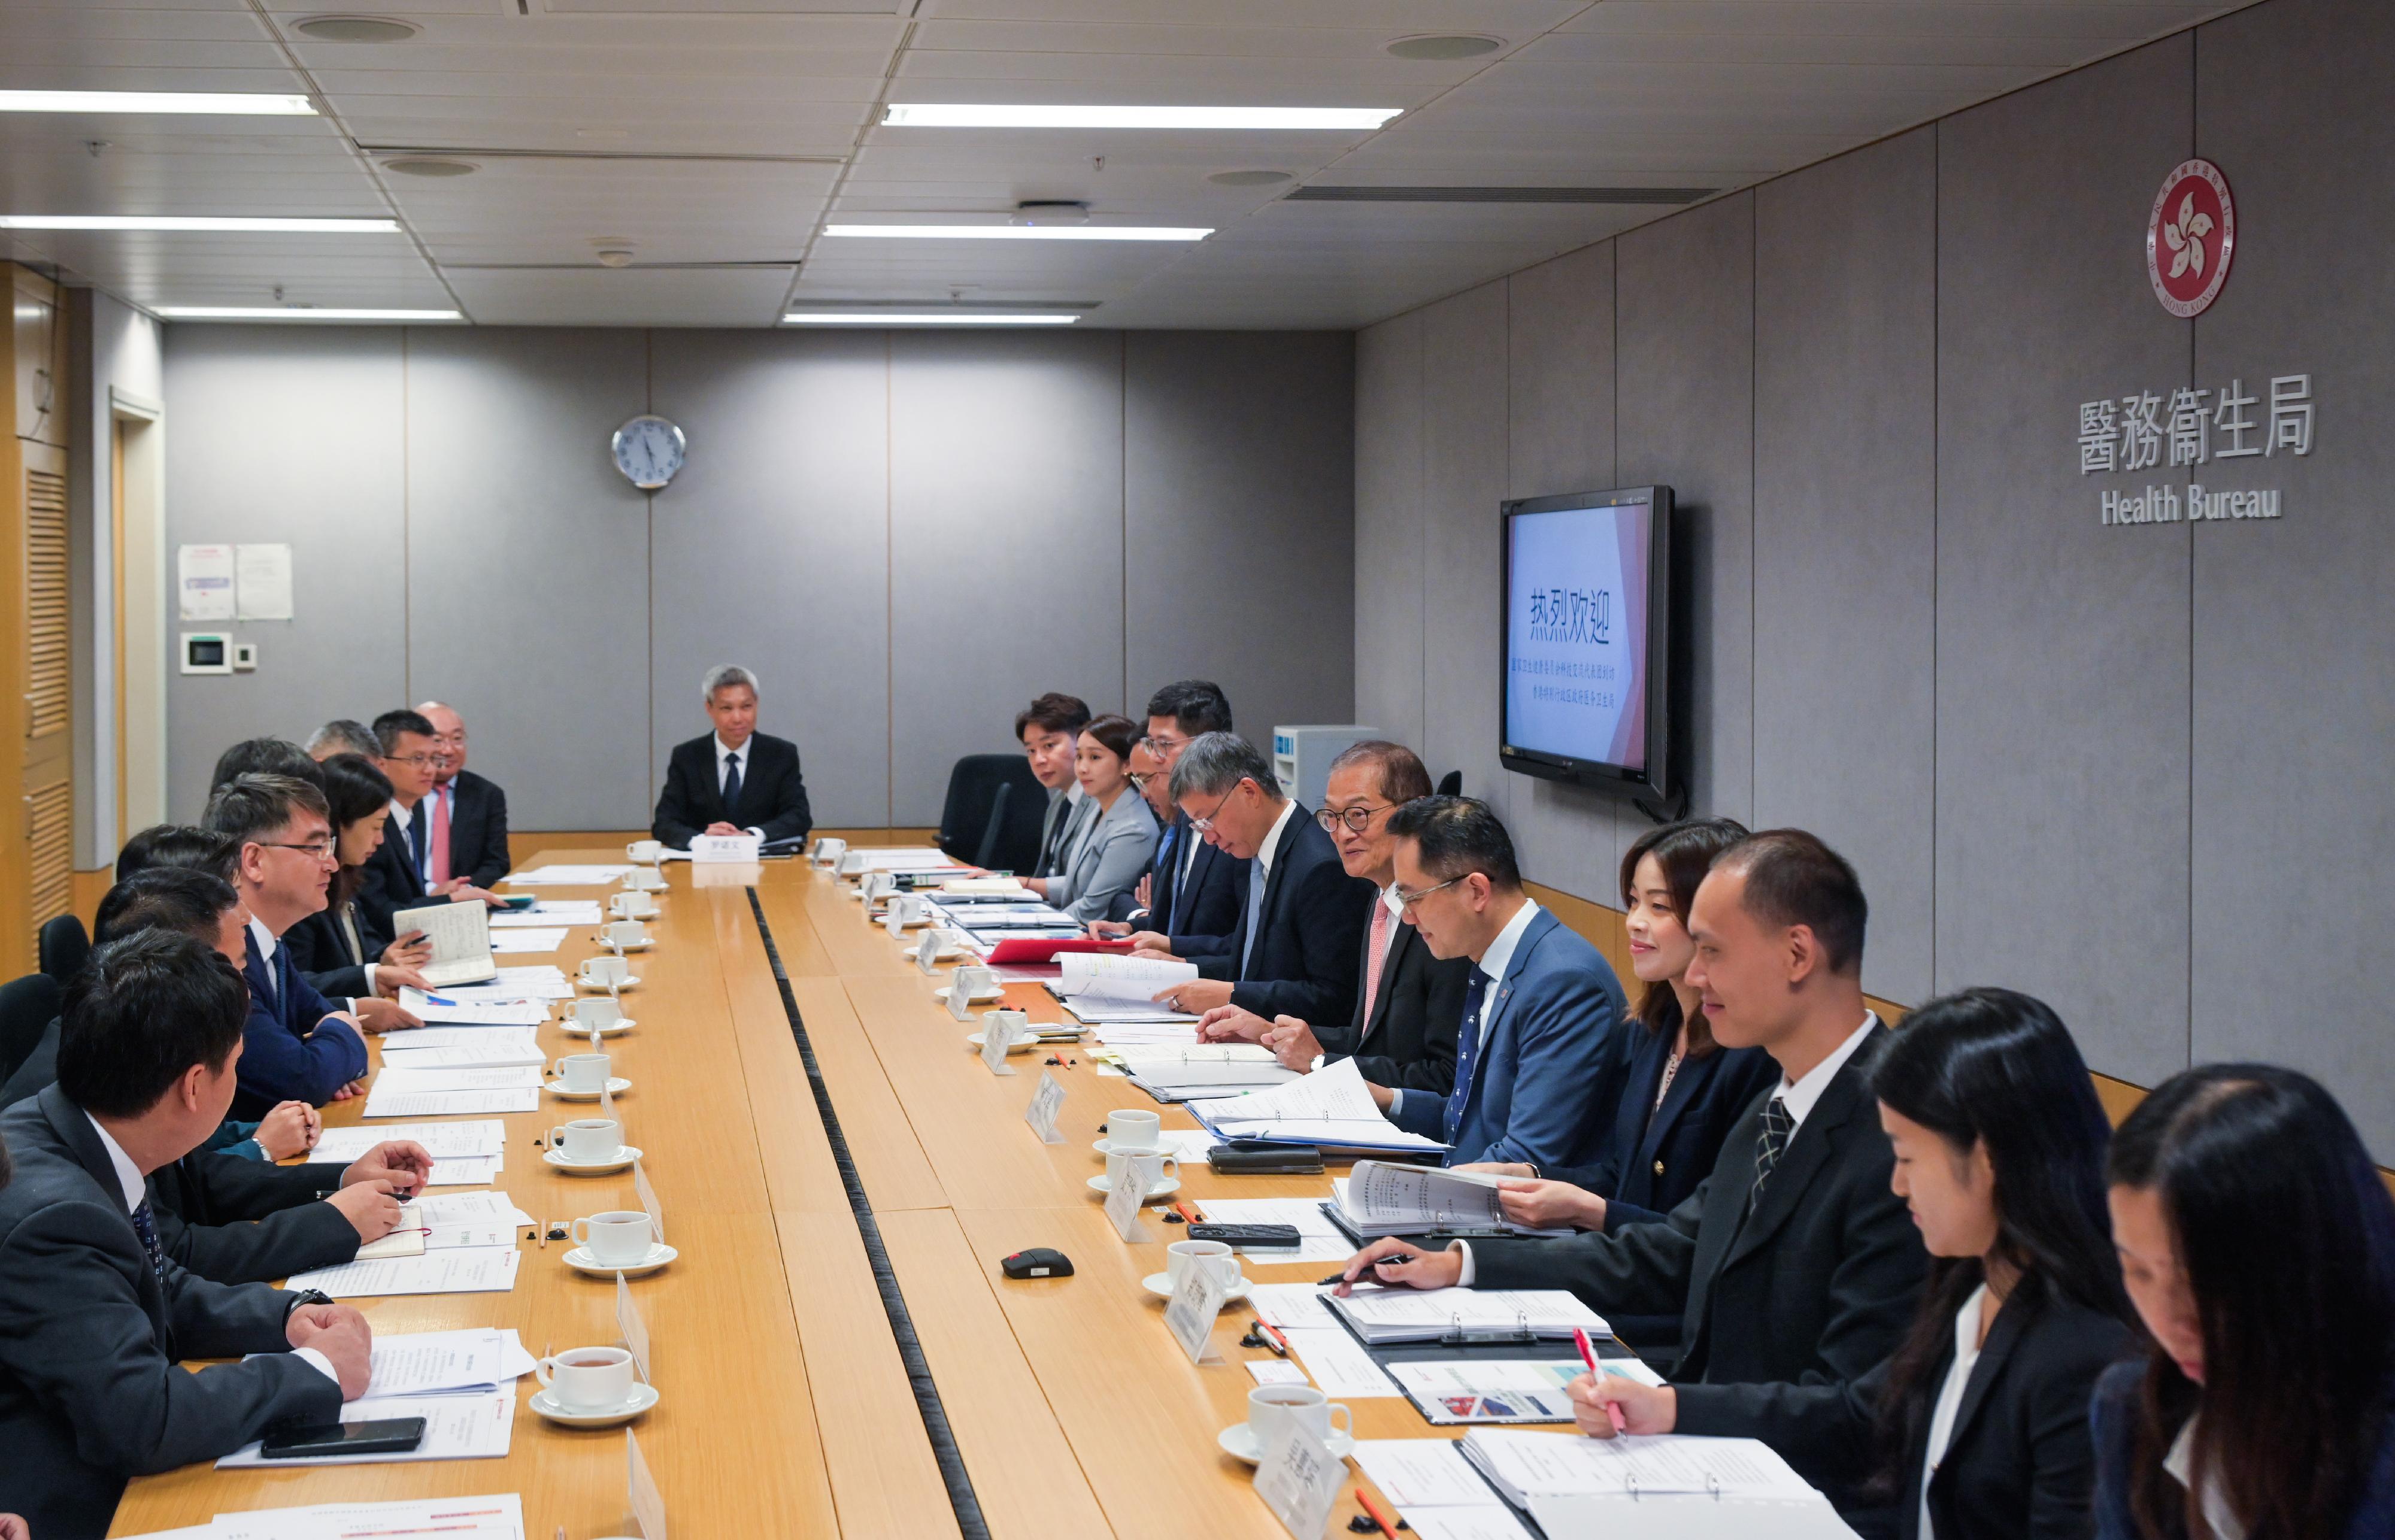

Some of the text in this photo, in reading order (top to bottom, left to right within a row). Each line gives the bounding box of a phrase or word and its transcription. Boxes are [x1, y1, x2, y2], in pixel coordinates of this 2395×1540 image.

[2163, 287, 2215, 314] HONG KONG
[2102, 484, 2282, 525] Health Bureau
[1530, 587, 1609, 645] 热烈欢迎
